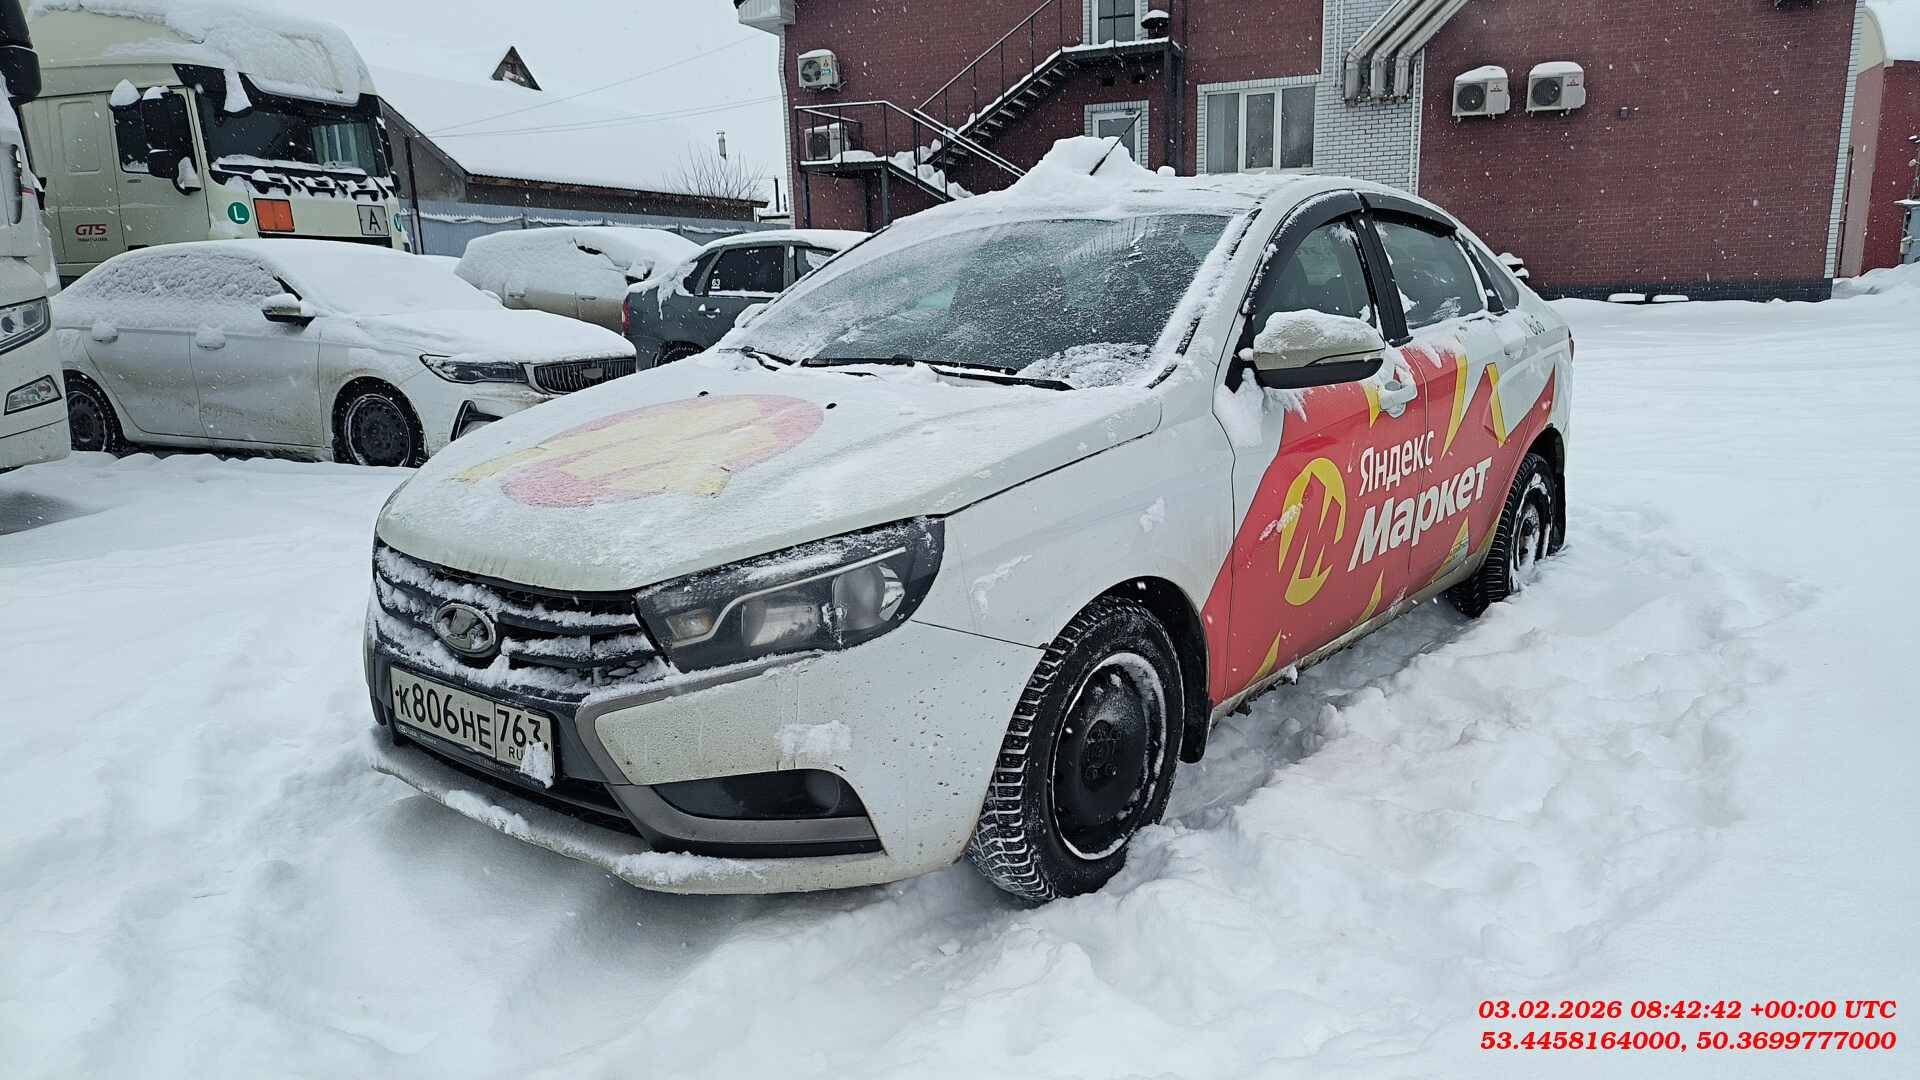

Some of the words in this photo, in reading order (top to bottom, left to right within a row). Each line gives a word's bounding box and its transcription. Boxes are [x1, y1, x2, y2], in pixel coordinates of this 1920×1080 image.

[75, 223, 107, 236] GTS
[368, 207, 382, 232] A
[1359, 430, 1435, 497] Яндекс
[1347, 456, 1493, 573] Маркет
[397, 682, 492, 750] К806НЕ
[497, 708, 541, 747] 763
[508, 745, 525, 761] RU
